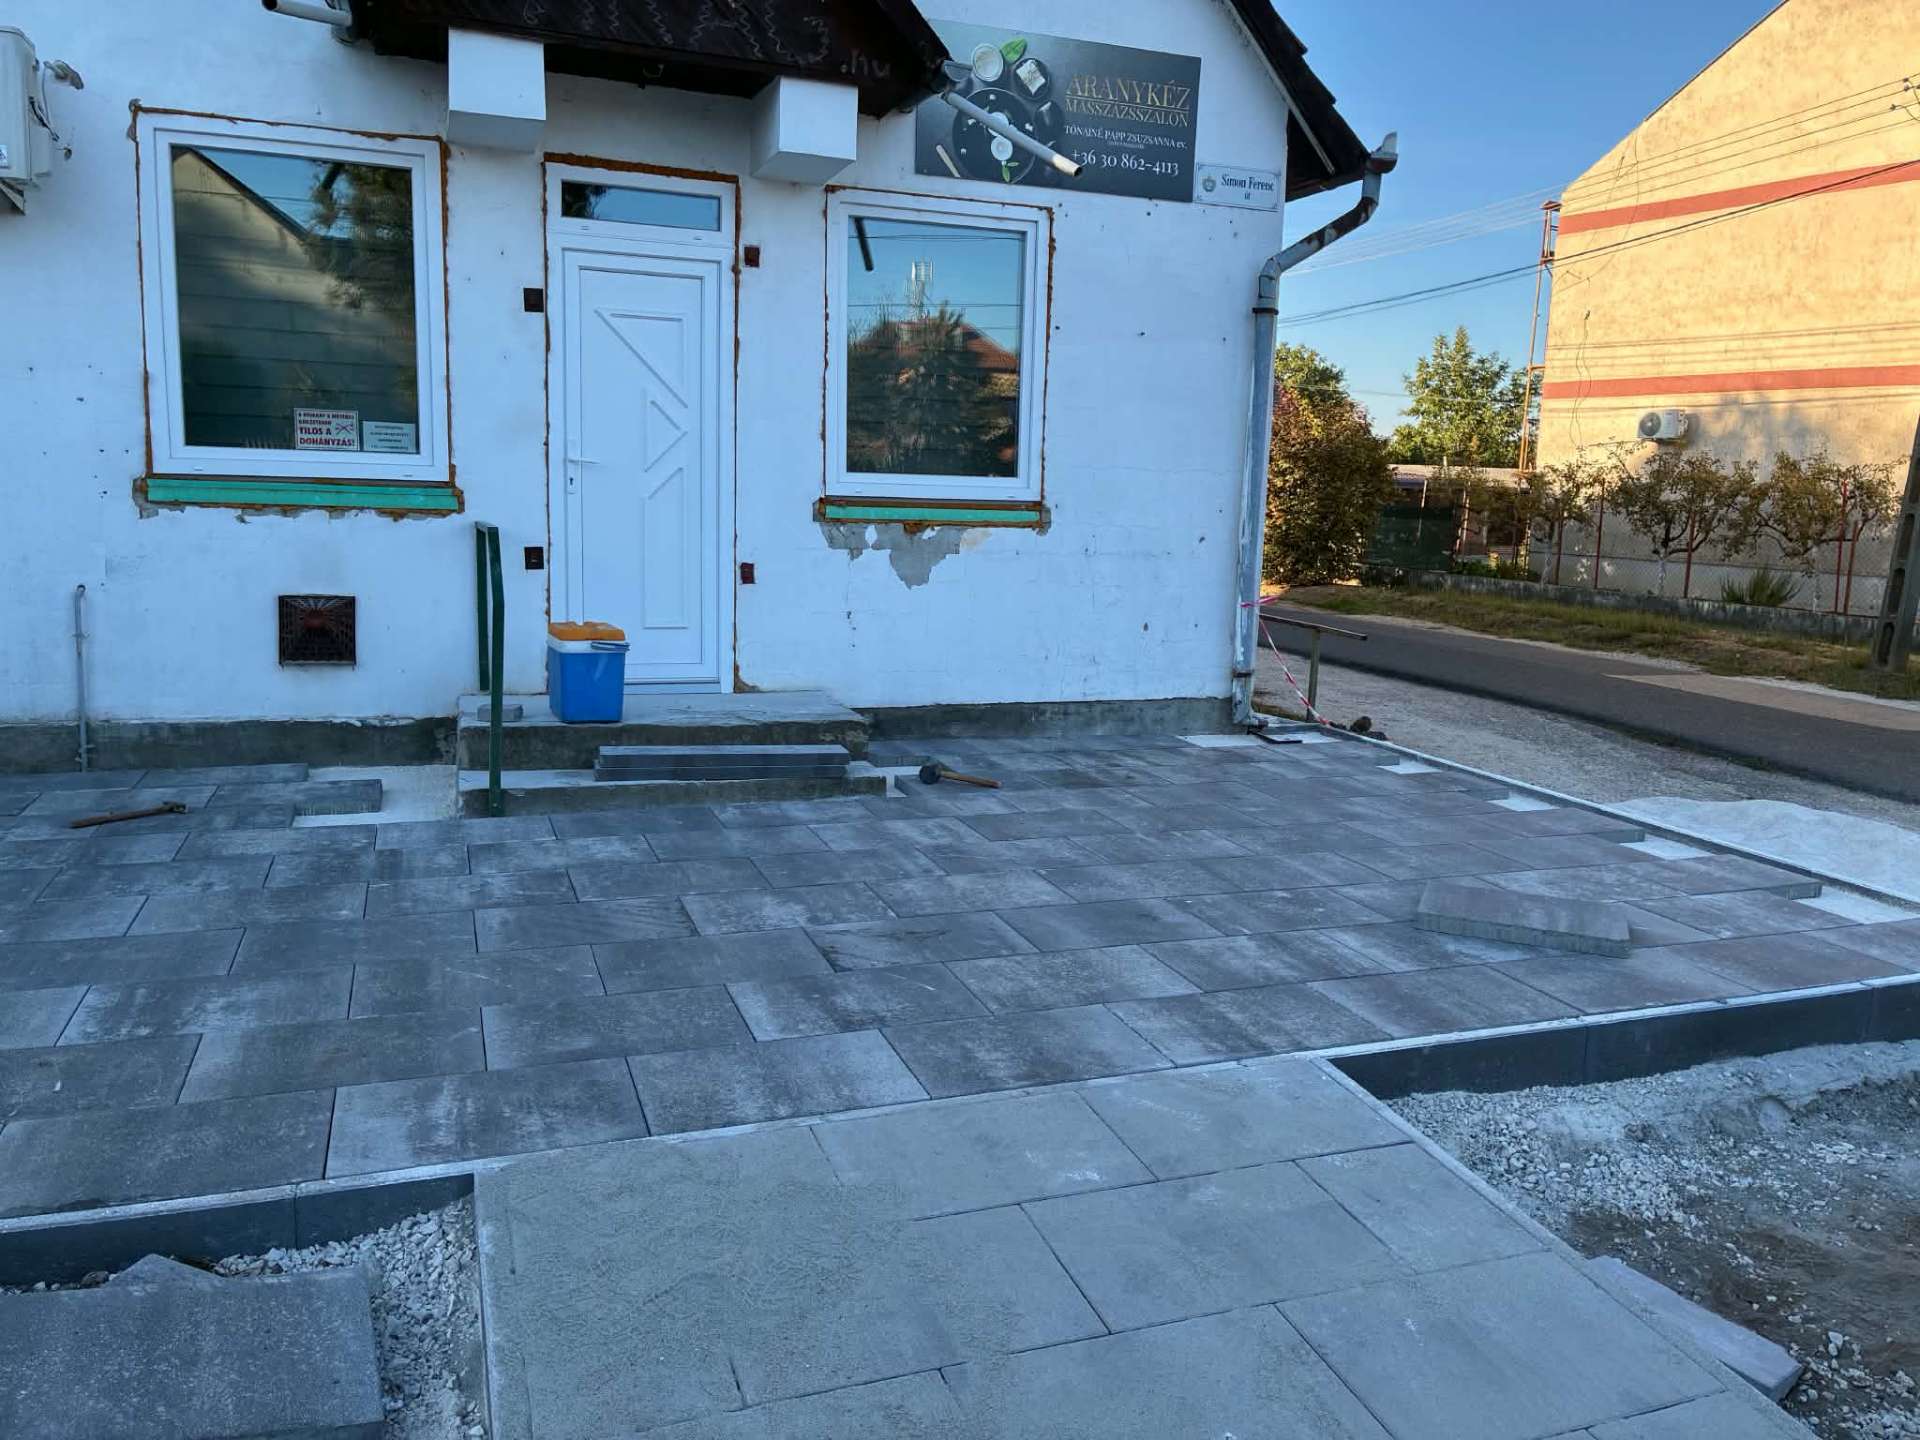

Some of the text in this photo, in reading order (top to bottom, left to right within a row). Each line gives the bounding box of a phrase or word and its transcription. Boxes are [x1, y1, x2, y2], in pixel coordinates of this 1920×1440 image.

[1065, 73, 1191, 110] ARANYKÉZ
[1072, 149, 1179, 176] +36 30 862-4113
[1221, 173, 1274, 192] Simon Ferenc
[300, 427, 322, 435] TILOS
